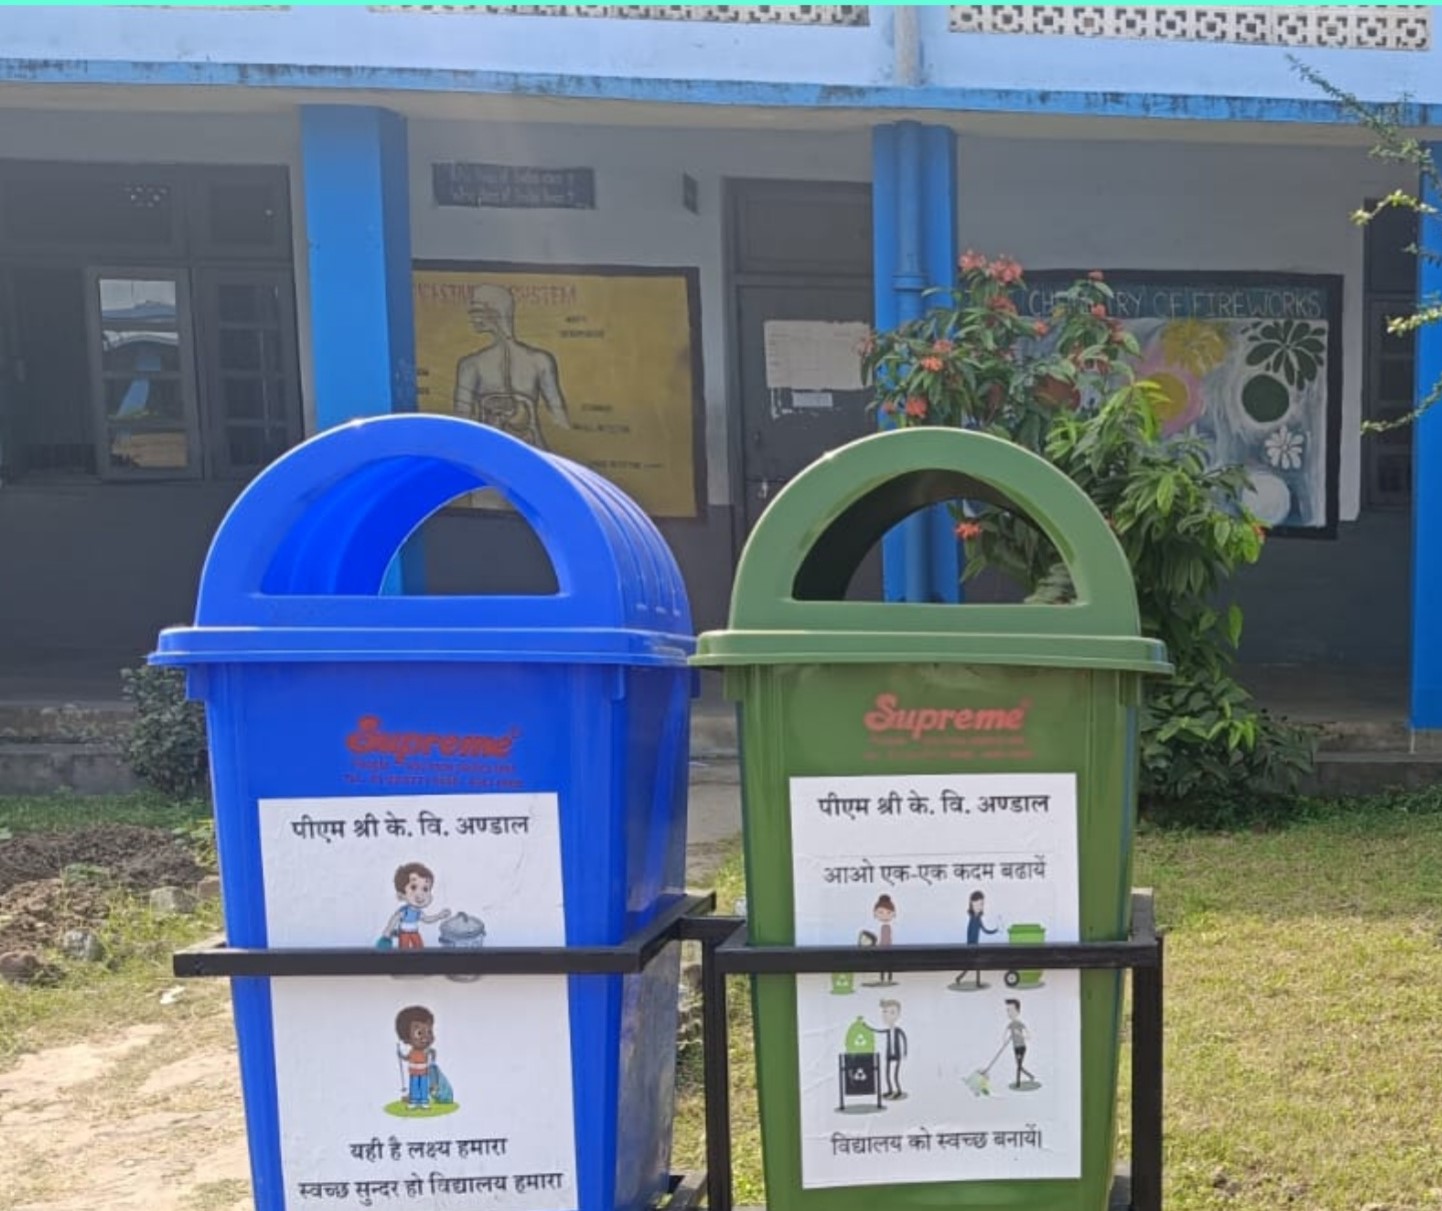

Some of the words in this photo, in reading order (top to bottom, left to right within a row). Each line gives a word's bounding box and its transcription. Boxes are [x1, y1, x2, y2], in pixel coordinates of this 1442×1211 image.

[864, 693, 1033, 741] Supreme
[817, 792, 871, 820] पीएम
[877, 791, 903, 815] श्री
[907, 790, 934, 815] के.
[940, 789, 970, 814] वि.
[978, 795, 1050, 813] अण्डाल
[291, 814, 346, 843] पीएम
[354, 813, 380, 838] श्री
[384, 811, 412, 837] के.
[417, 810, 449, 836] वि.
[456, 816, 530, 835] अण्डाल
[824, 860, 875, 884] आओ
[879, 864, 948, 886] एक-एक
[952, 863, 995, 880] कदम
[349, 1137, 384, 1162] यही
[388, 1136, 402, 1161] है
[406, 1141, 453, 1158] लक्ष्य
[455, 1138, 508, 1158] हमारा
[830, 1132, 903, 1155] विद्यालय
[907, 1126, 933, 1150] को
[936, 1131, 989, 1149] स्वच्छ
[298, 1182, 350, 1199] स्वच्छ
[354, 1181, 399, 1206] सुन्दर
[403, 1173, 424, 1197] हो
[428, 1171, 508, 1194] विद्यालय
[513, 1173, 564, 1193] हमारा
